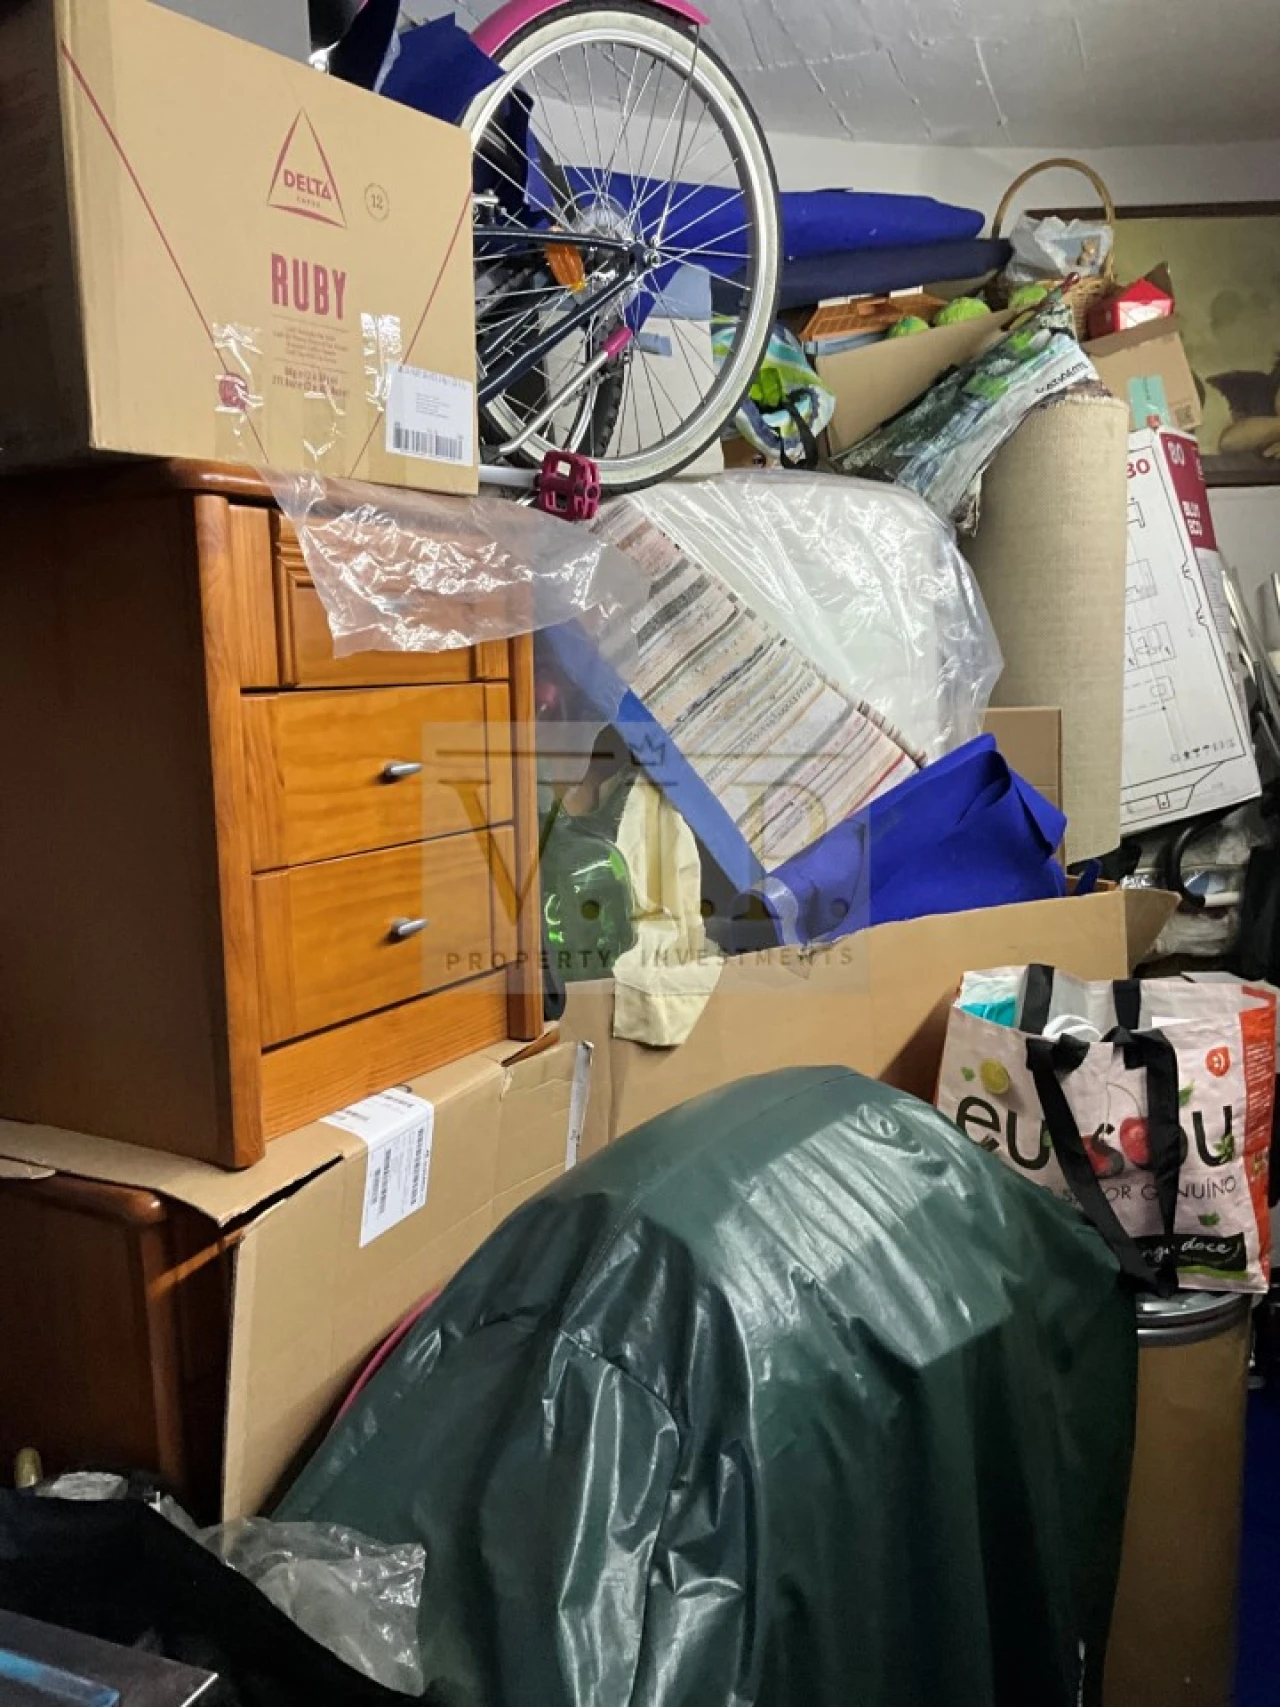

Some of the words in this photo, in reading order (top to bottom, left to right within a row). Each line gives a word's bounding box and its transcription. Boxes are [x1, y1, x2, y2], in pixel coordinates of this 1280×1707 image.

[283, 168, 332, 200] DELTA
[370, 194, 384, 211] 12
[271, 252, 347, 320] RUBY
[956, 1096, 1052, 1171] eu
[1140, 1174, 1237, 1201] GNUÍNO
